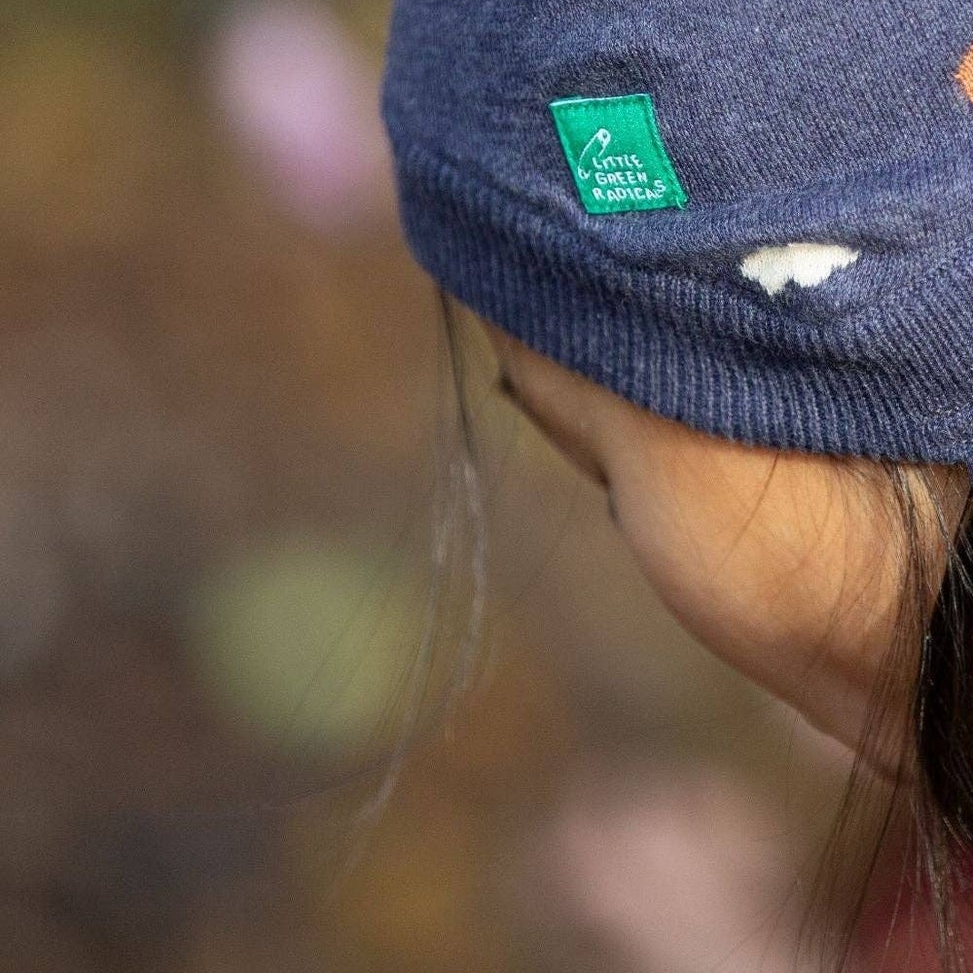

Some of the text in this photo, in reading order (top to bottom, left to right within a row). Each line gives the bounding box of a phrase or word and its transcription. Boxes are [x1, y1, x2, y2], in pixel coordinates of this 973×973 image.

[592, 154, 643, 169] LITTLE
[595, 171, 648, 185] GREEN
[592, 179, 666, 202] RADICALS
